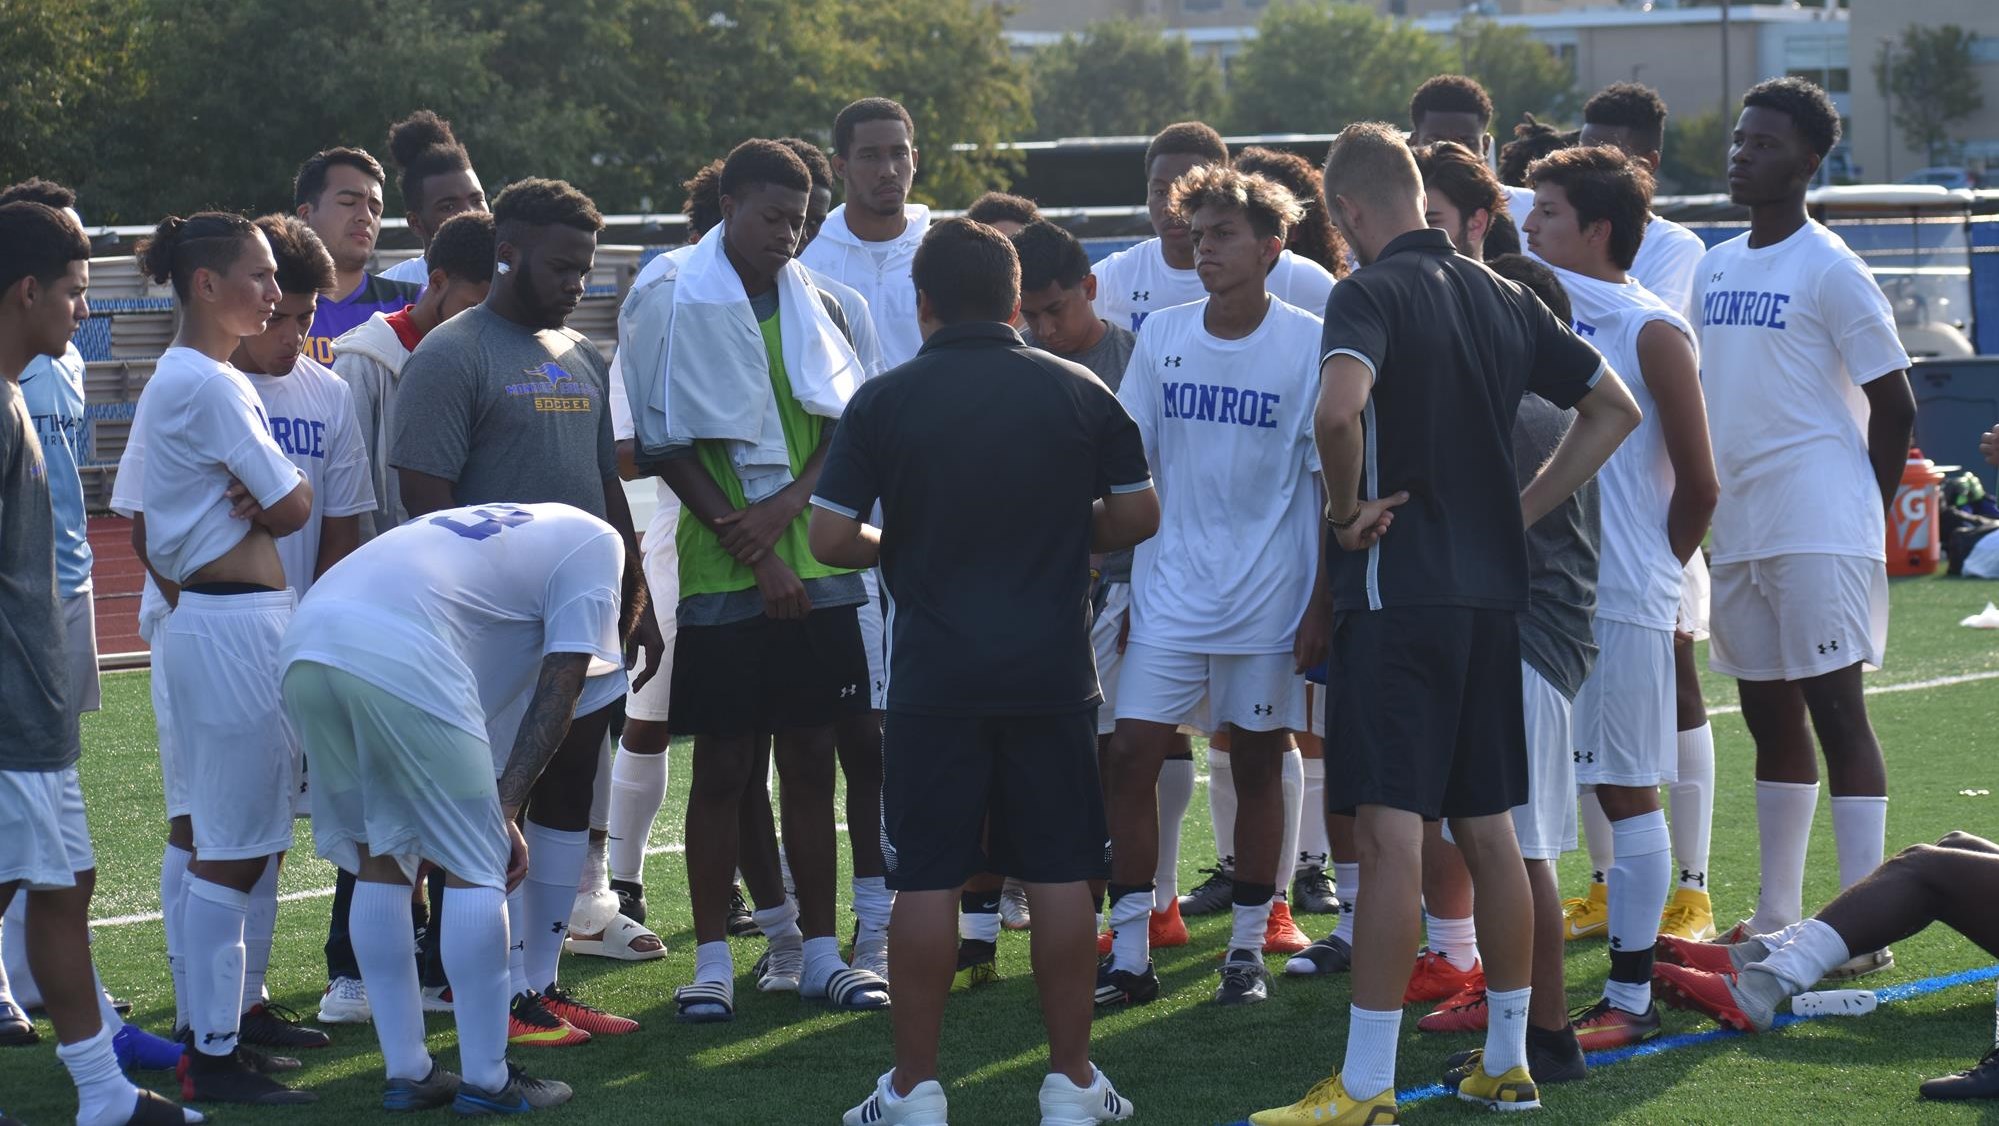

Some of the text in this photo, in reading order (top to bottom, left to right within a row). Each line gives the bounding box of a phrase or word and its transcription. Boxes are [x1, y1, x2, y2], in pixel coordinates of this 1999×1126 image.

[1703, 291, 1790, 330] MONROE
[535, 400, 591, 410] SOCCER
[1162, 382, 1280, 428] MONROE
[1901, 489, 1926, 520] G
